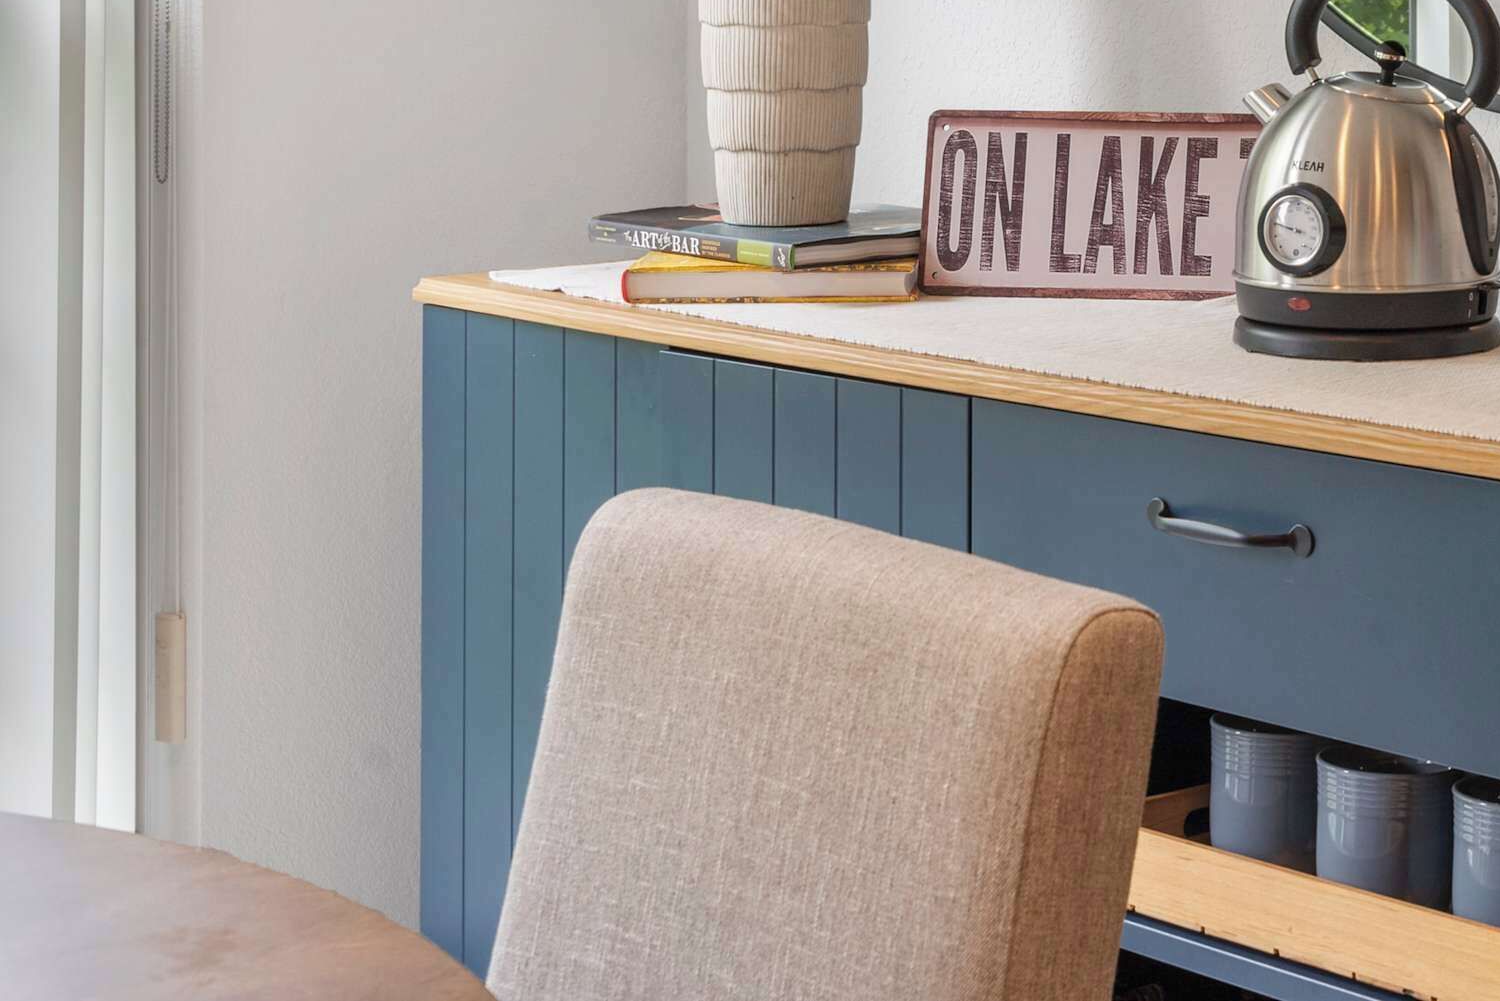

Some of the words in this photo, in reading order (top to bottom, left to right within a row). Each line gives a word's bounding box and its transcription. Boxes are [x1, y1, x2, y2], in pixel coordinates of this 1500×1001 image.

[632, 230, 660, 250] ART
[671, 234, 701, 256] BAR
[936, 128, 1028, 272] ON
[1048, 132, 1219, 277] LAKE
